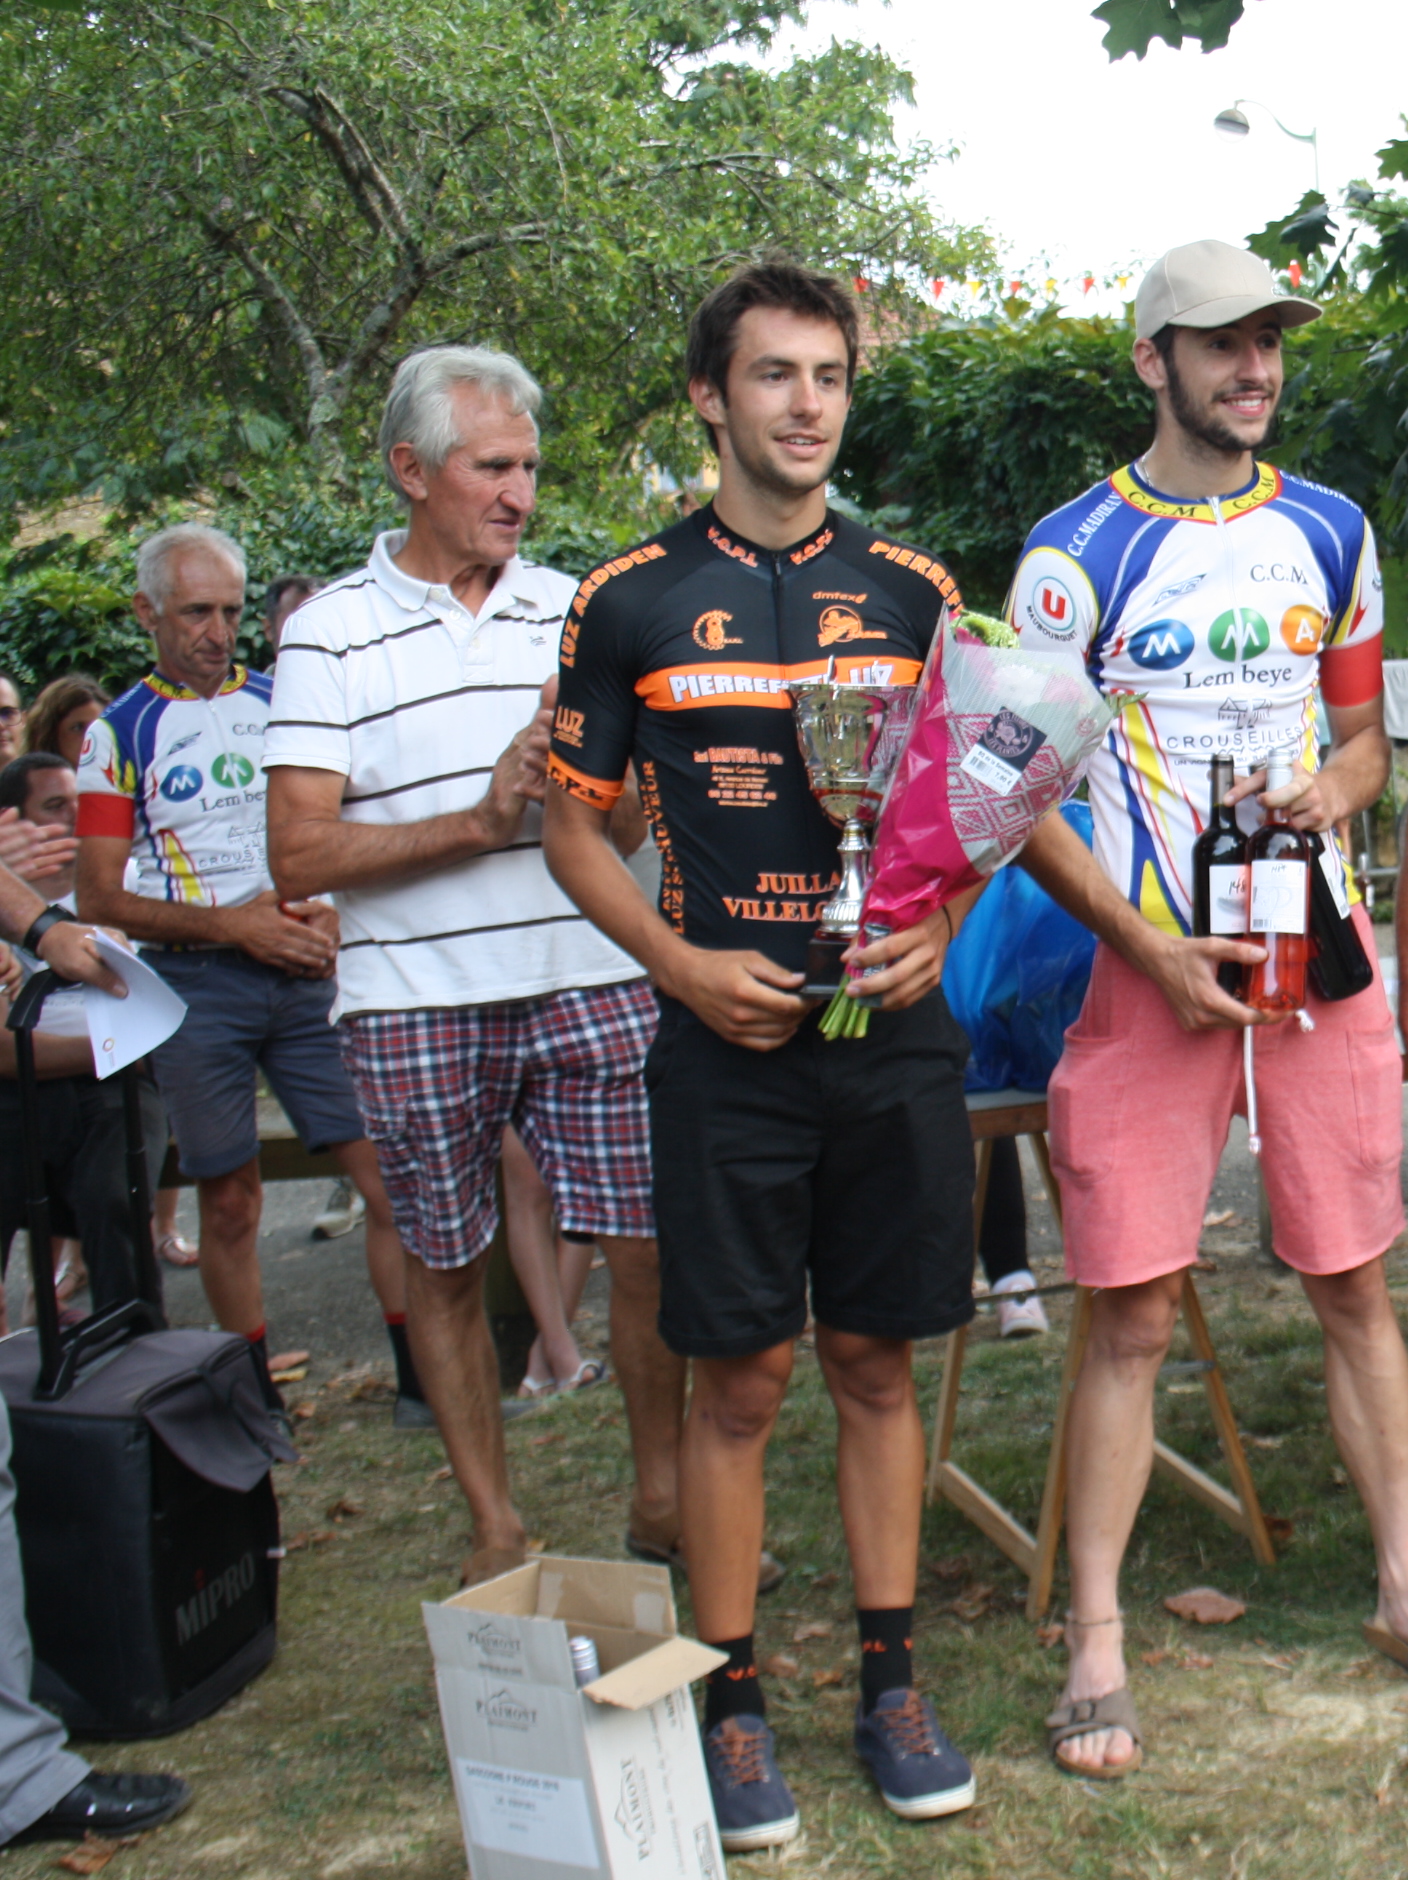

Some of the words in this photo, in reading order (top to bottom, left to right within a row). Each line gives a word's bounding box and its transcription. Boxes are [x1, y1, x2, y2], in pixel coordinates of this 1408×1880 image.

[869, 540, 967, 614] PIERREF
[1250, 563, 1309, 586] C.C.M
[560, 617, 581, 668] LUZ
[573, 543, 668, 618] ARDIDEN
[669, 673, 830, 702] PIERREF
[555, 705, 585, 738] LUZ
[1166, 726, 1303, 749] CROUSEILLES
[200, 788, 267, 813] Lembe
[756, 871, 841, 894] JUILLA
[722, 897, 828, 922] VILLELO
[175, 1551, 256, 1647] MIPRO
